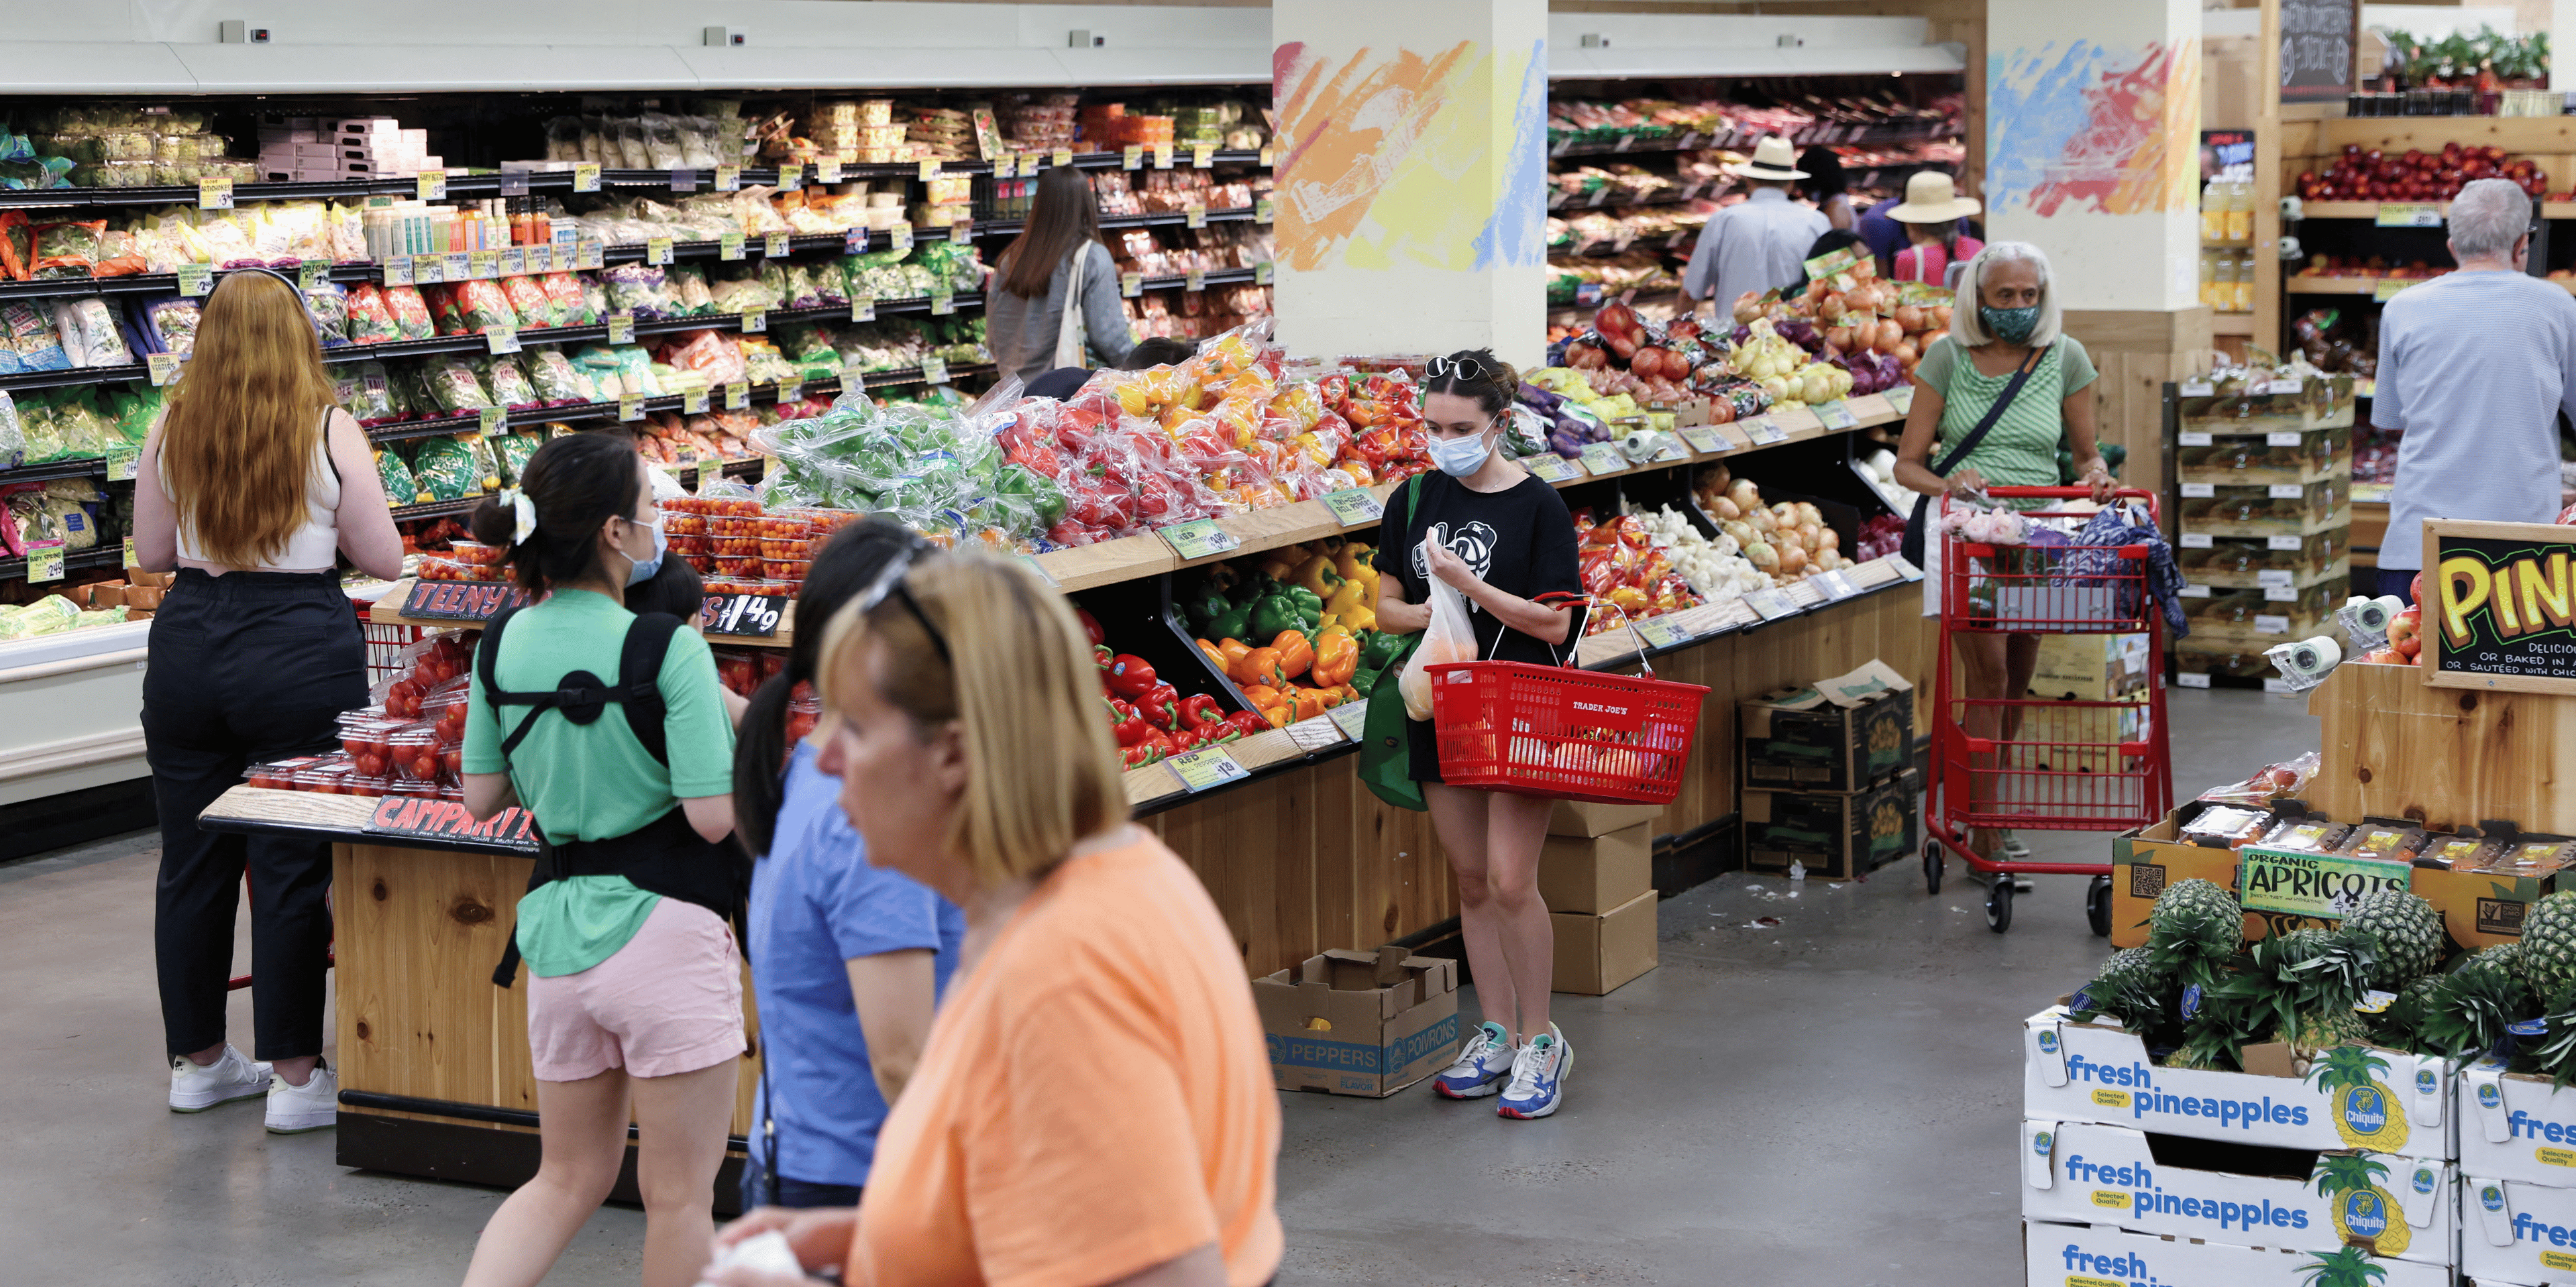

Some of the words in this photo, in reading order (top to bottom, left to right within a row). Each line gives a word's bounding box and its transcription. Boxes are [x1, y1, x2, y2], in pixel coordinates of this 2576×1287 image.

[200, 184, 231, 192] ARTICHOKES
[429, 457, 464, 465] TUSCAN
[1332, 494, 1365, 506] TRI-COLOR
[1336, 504, 1352, 513] BELL
[1350, 499, 1373, 510] PEPPERS
[1176, 531, 1195, 541] RED
[44, 552, 62, 560] SPRING
[412, 582, 508, 616] TEENY
[2439, 553, 2576, 647] PIN
[2479, 652, 2498, 662] OR
[2504, 655, 2545, 665] BAKED
[2552, 658, 2565, 666] IN
[2446, 661, 2461, 669] OR
[2469, 661, 2520, 674] SAUTÉED
[2525, 667, 2548, 675] WITH
[2552, 669, 2576, 677] CHIC
[1572, 701, 1604, 713] TRADER
[1604, 705, 1629, 716] JOE'S
[1338, 716, 1353, 725] BELL
[1350, 711, 1366, 720] PEPP
[1177, 754, 1199, 766] RED
[1177, 767, 1195, 775] BELL
[1193, 757, 1222, 770] PEPPERS
[2248, 853, 2319, 870] ORGANIC
[2249, 864, 2406, 900] APRICOTS
[1407, 1018, 1457, 1059] POIVRONS
[2039, 1041, 2059, 1052] Chiquita
[1291, 1043, 1377, 1068] PEPPERS
[2067, 1054, 2151, 1088] fresh
[1340, 1079, 1375, 1090] FLAVOR
[2416, 1082, 2436, 1090] Chiquita
[2097, 1092, 2125, 1100] Selected
[2097, 1098, 2121, 1106] Quality
[2135, 1086, 2309, 1129] pineapples
[2345, 1110, 2385, 1127] Chiquita
[2508, 1110, 2576, 1145] fres
[2035, 1144, 2051, 1153] Chiqui
[2542, 1150, 2573, 1159] Selected
[2541, 1156, 2568, 1166] Quality
[2065, 1155, 2152, 1188] fresh
[2096, 1192, 2125, 1200] Selected
[2096, 1198, 2121, 1207] Quality
[2135, 1187, 2309, 1232] pineapples
[2345, 1214, 2385, 1230] Chiquita
[2512, 1213, 2576, 1247] fre
[2062, 1244, 2147, 1280] fresh
[2546, 1260, 2573, 1270] Quality
